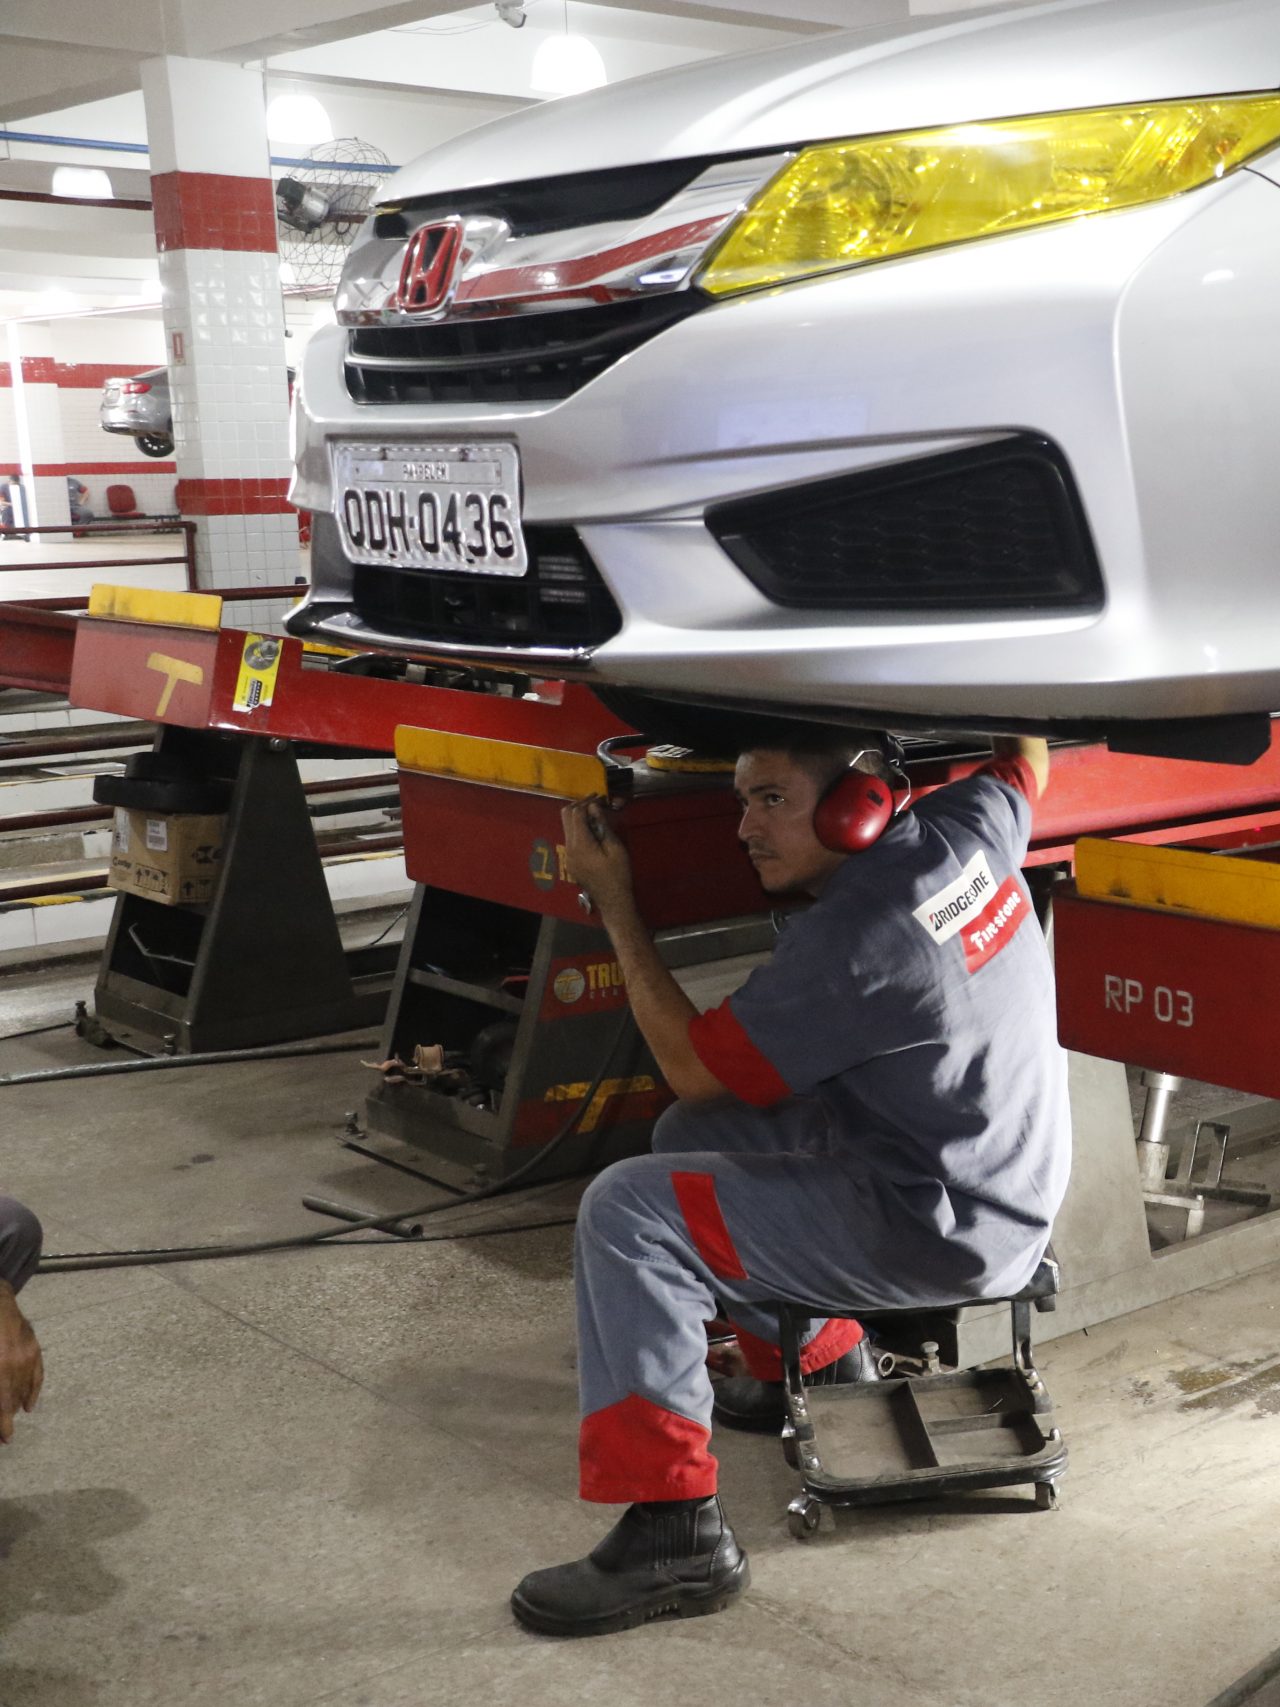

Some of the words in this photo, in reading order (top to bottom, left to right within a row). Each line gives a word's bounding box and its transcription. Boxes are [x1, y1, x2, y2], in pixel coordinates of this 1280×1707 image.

[585, 962, 626, 990] TRU
[1104, 974, 1144, 1014] RP
[1154, 985, 1194, 1027] 03
